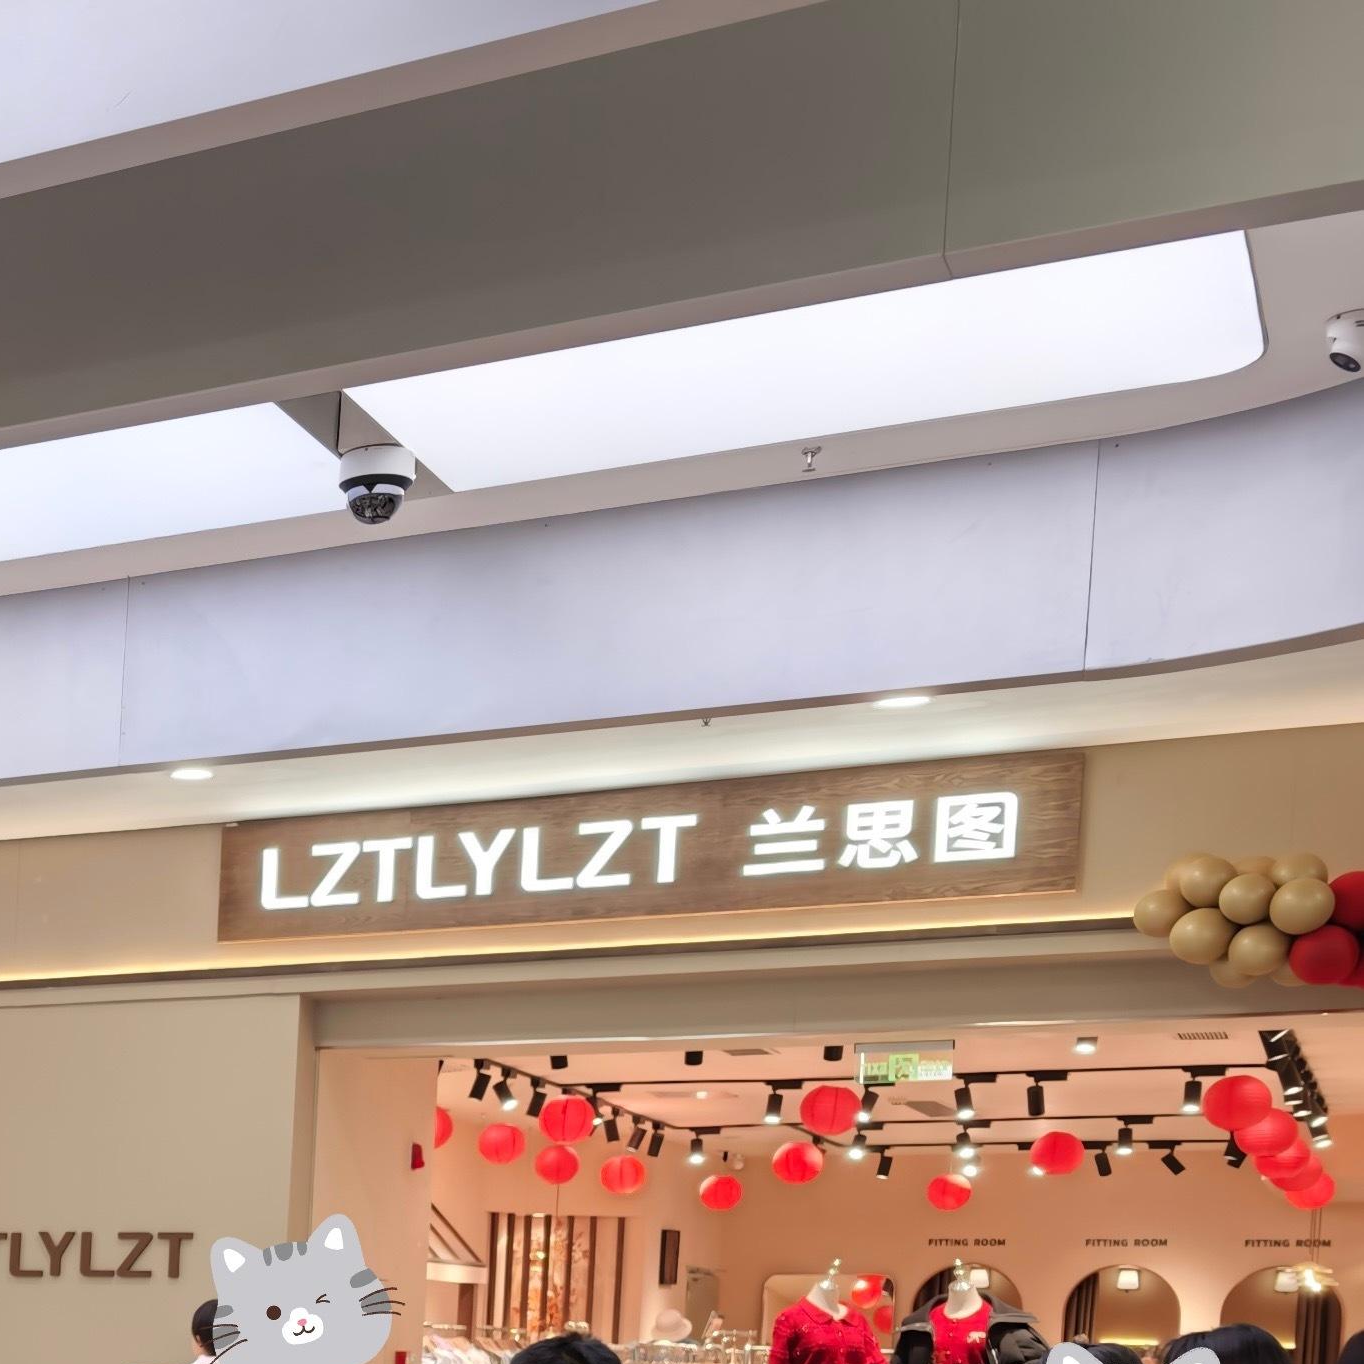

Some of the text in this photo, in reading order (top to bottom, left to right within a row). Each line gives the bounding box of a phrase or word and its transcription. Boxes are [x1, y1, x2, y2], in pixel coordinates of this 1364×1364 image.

[259, 791, 1020, 910] LZTLYLZT 兰思图
[928, 1238, 1006, 1247] FITTING ROOM
[1085, 1238, 1168, 1248] FITTING ROOM
[1244, 1239, 1332, 1248] FITTING ROOM
